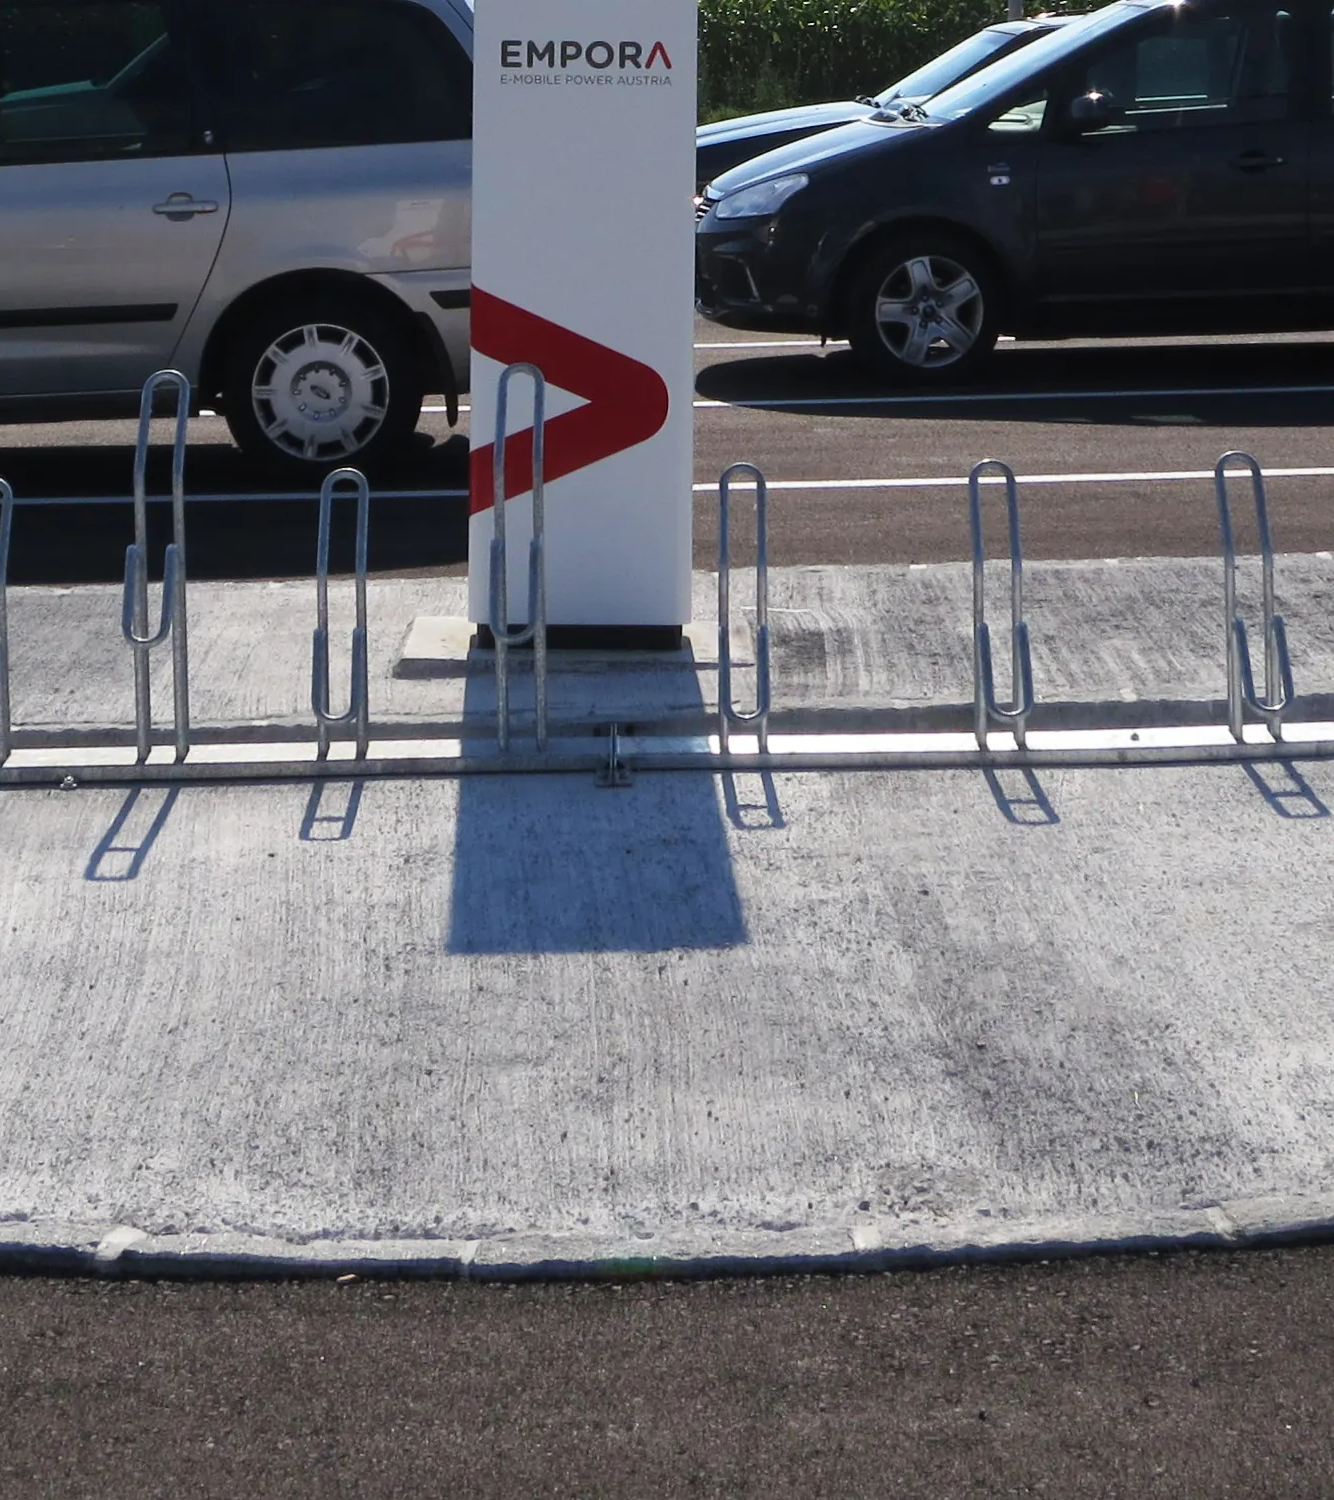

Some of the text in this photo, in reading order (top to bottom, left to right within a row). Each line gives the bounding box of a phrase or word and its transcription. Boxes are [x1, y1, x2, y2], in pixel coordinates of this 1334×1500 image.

[500, 40, 673, 69] EMPORA
[500, 74, 672, 87] E-MOBILE POWER AUSTRIA
